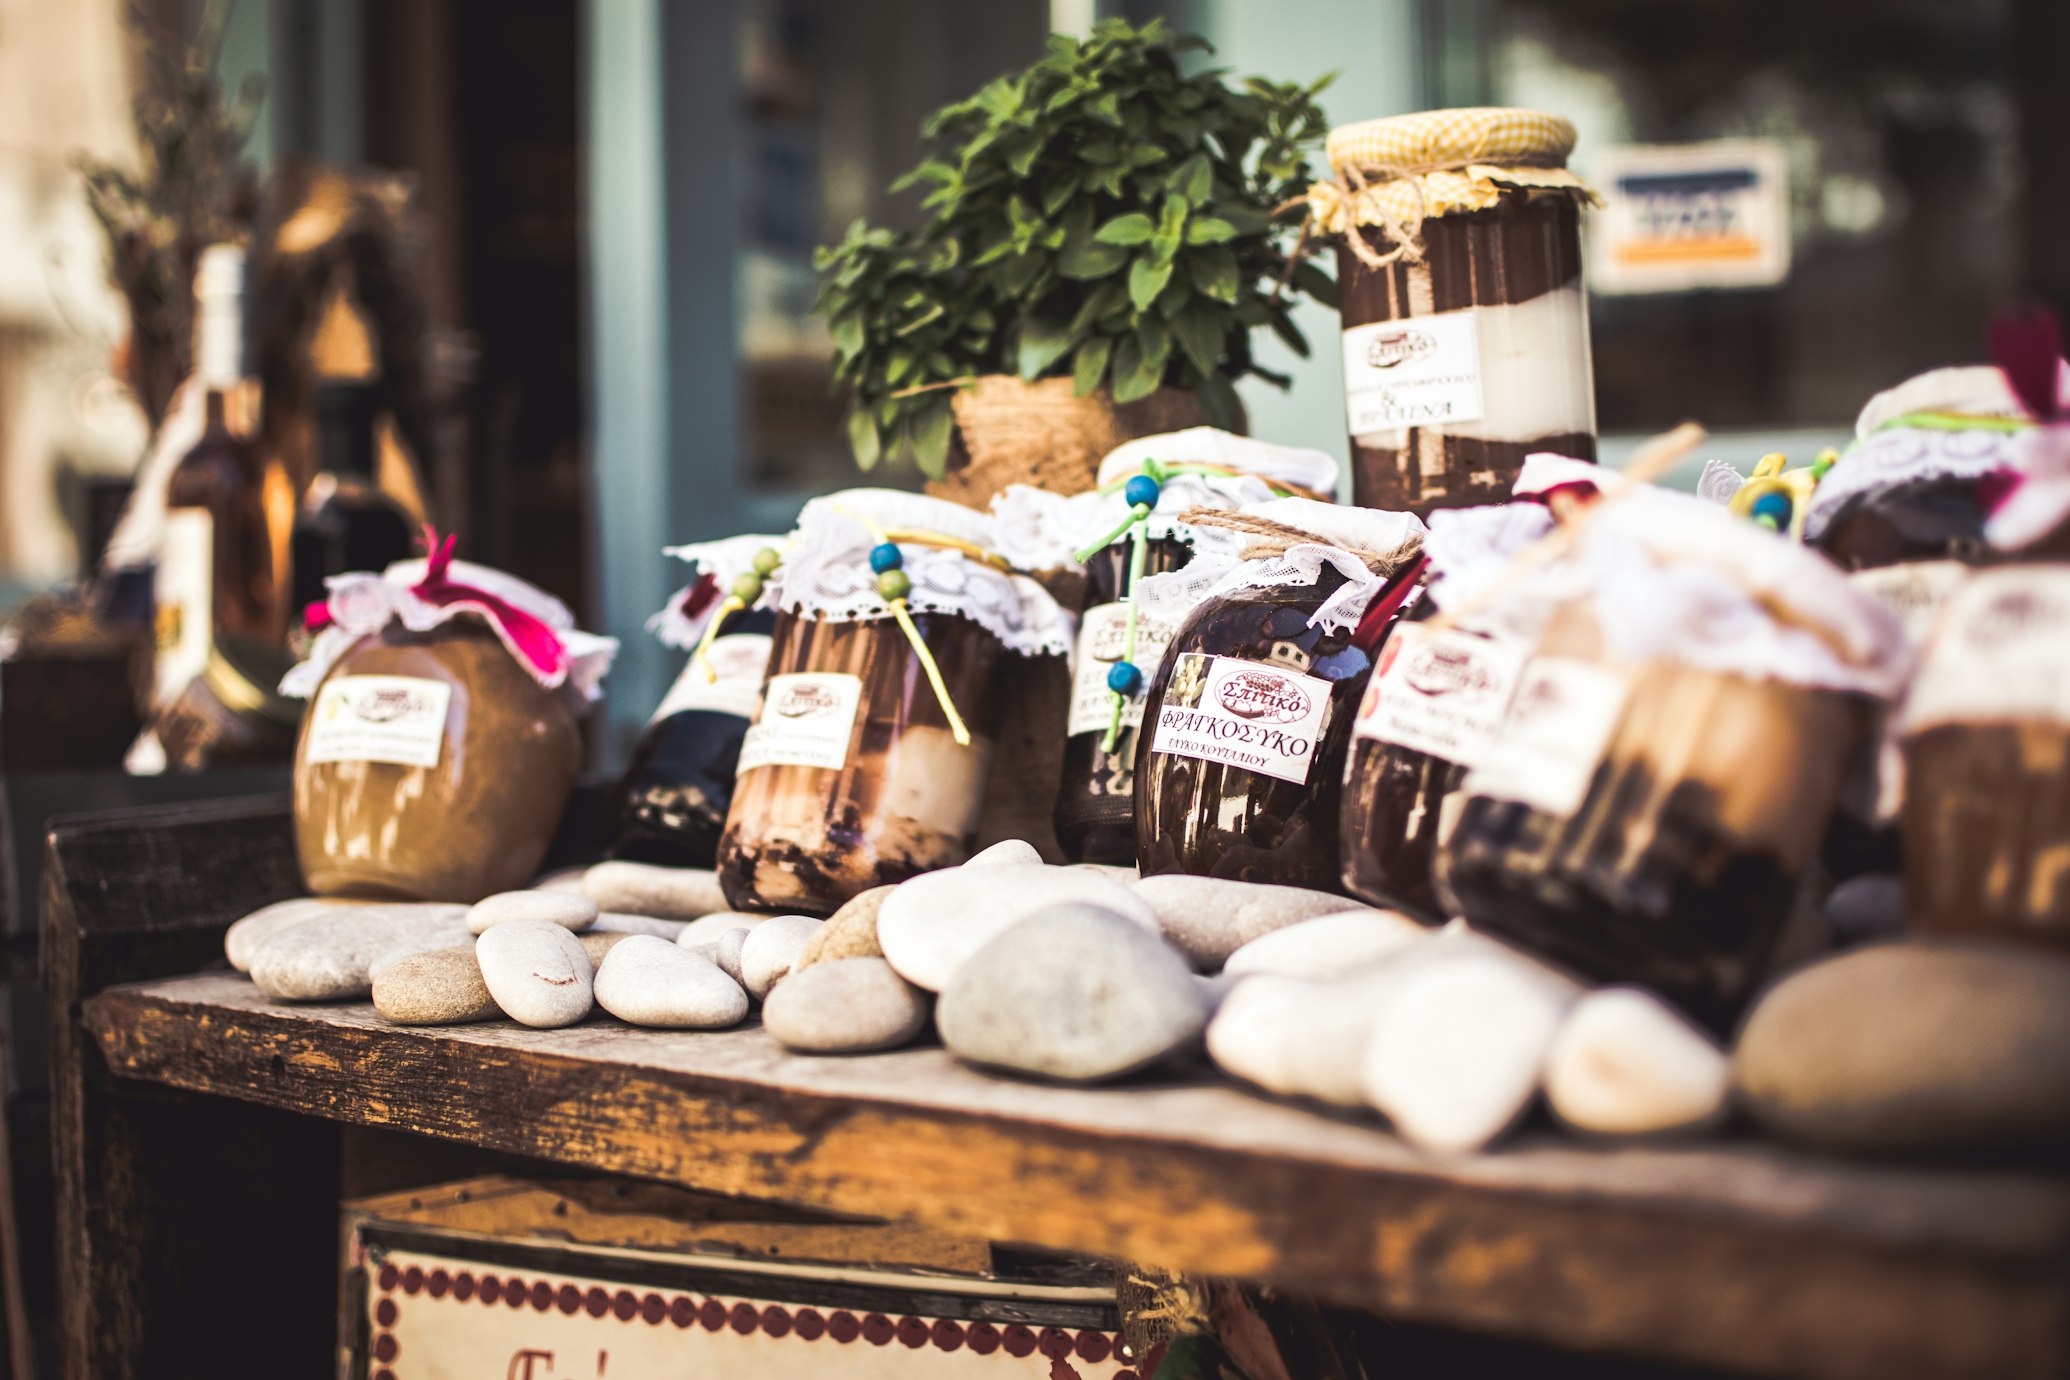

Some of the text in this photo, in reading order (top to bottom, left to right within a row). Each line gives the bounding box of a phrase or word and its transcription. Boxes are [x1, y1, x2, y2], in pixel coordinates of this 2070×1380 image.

[1223, 681, 1302, 713] Σπιτικό
[1161, 710, 1309, 758] ΦΡΑΓΚΟΣΥΚΟ
[1168, 738, 1271, 768] ΓΛΥΚΟ ΚΟΥΤΑΛΙΟΥ
